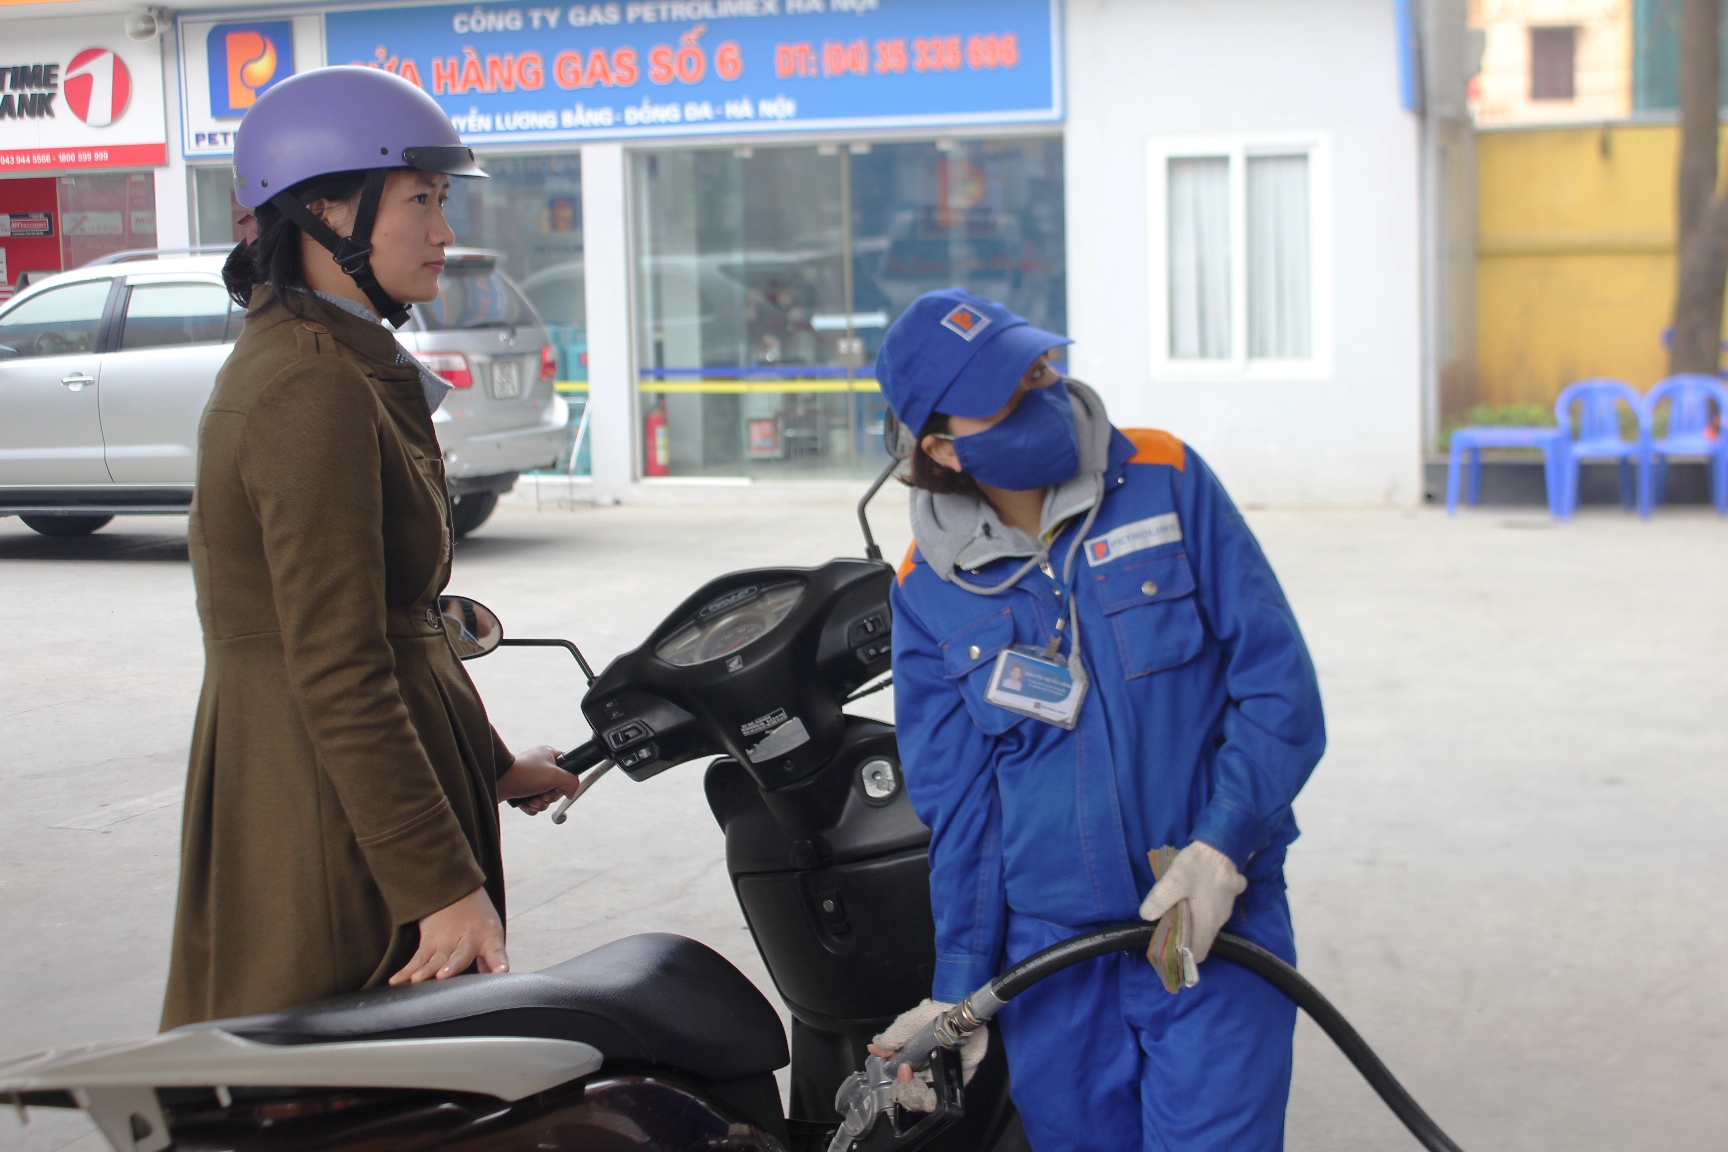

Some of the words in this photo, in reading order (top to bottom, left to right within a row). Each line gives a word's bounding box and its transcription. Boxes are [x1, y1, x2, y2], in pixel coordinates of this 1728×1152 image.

[528, 7, 560, 30] TY
[568, 4, 621, 27] GAS
[626, 0, 779, 24] PETROLIMEX
[432, 46, 544, 95] HÀNG
[553, 46, 638, 90] GAS
[648, 24, 707, 85] SỐ
[714, 41, 743, 81] 6
[0, 64, 59, 91] TIME
